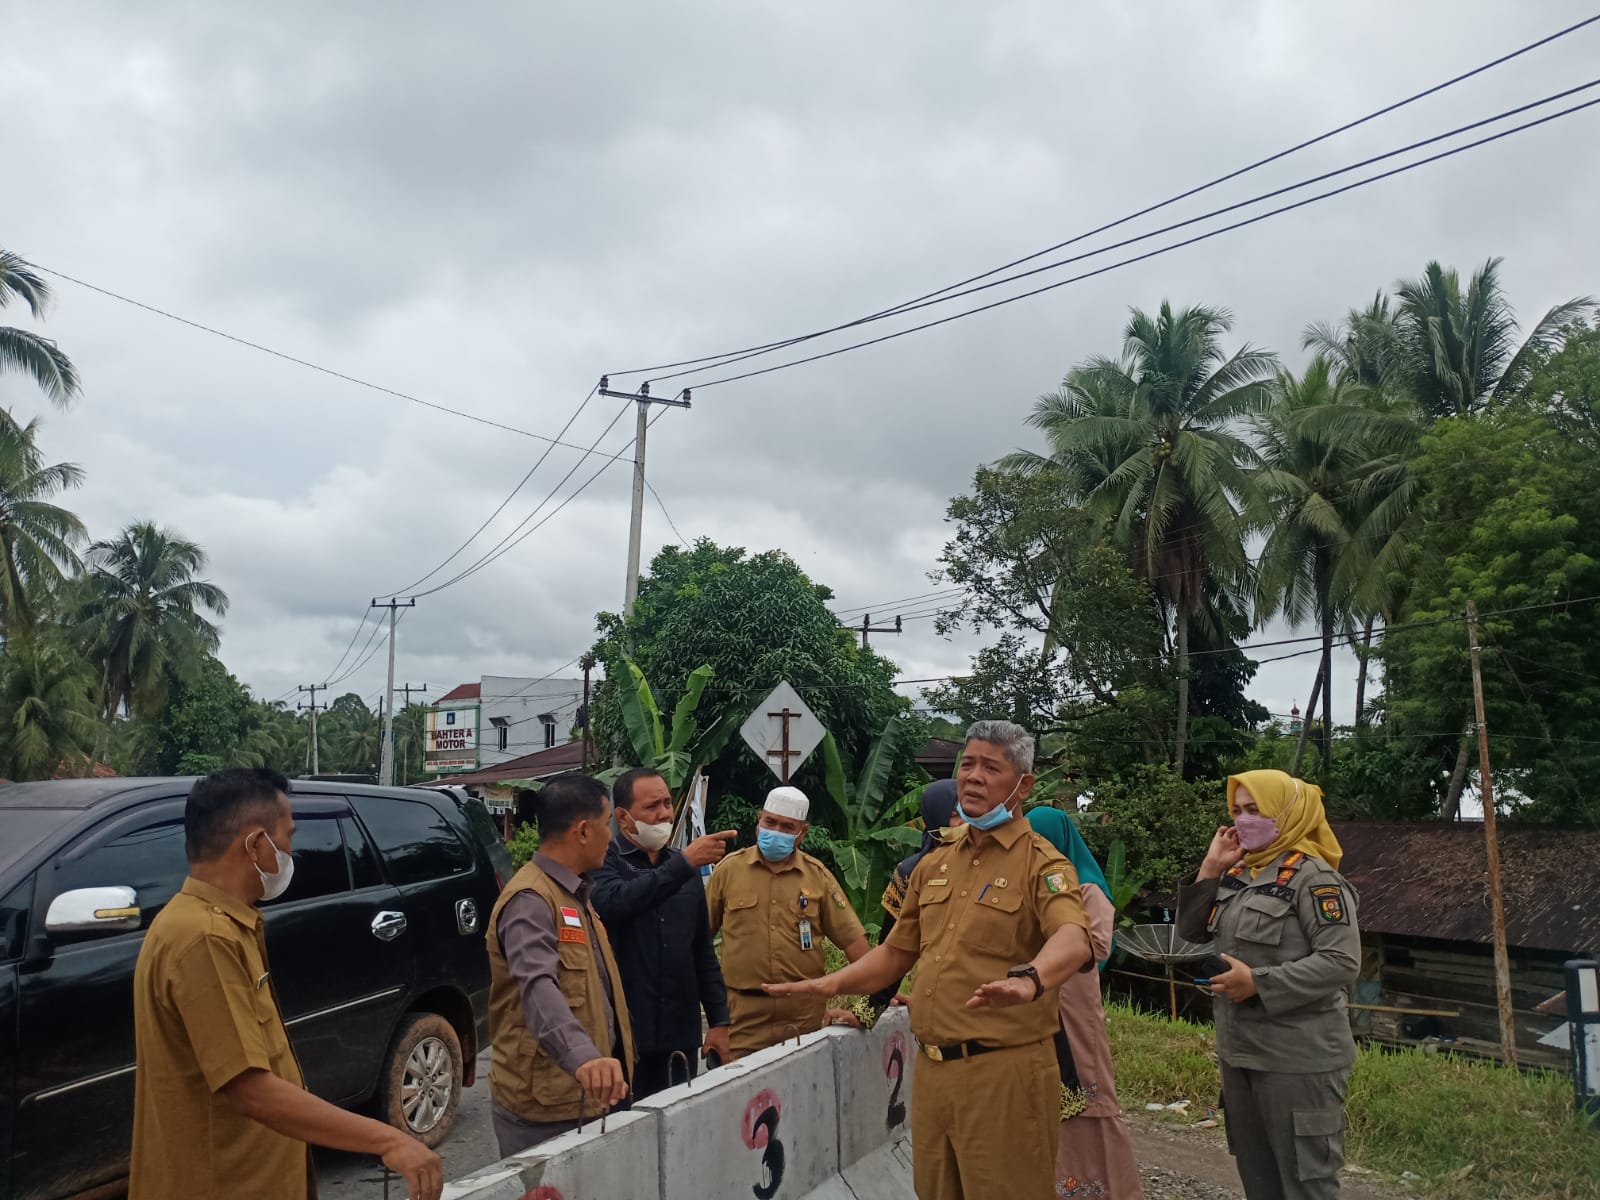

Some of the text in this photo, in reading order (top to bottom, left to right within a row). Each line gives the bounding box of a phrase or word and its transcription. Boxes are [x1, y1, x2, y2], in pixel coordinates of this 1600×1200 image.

[436, 739, 465, 750] MOTOR
[886, 1047, 906, 1131] 2
[752, 1105, 785, 1200] 3
